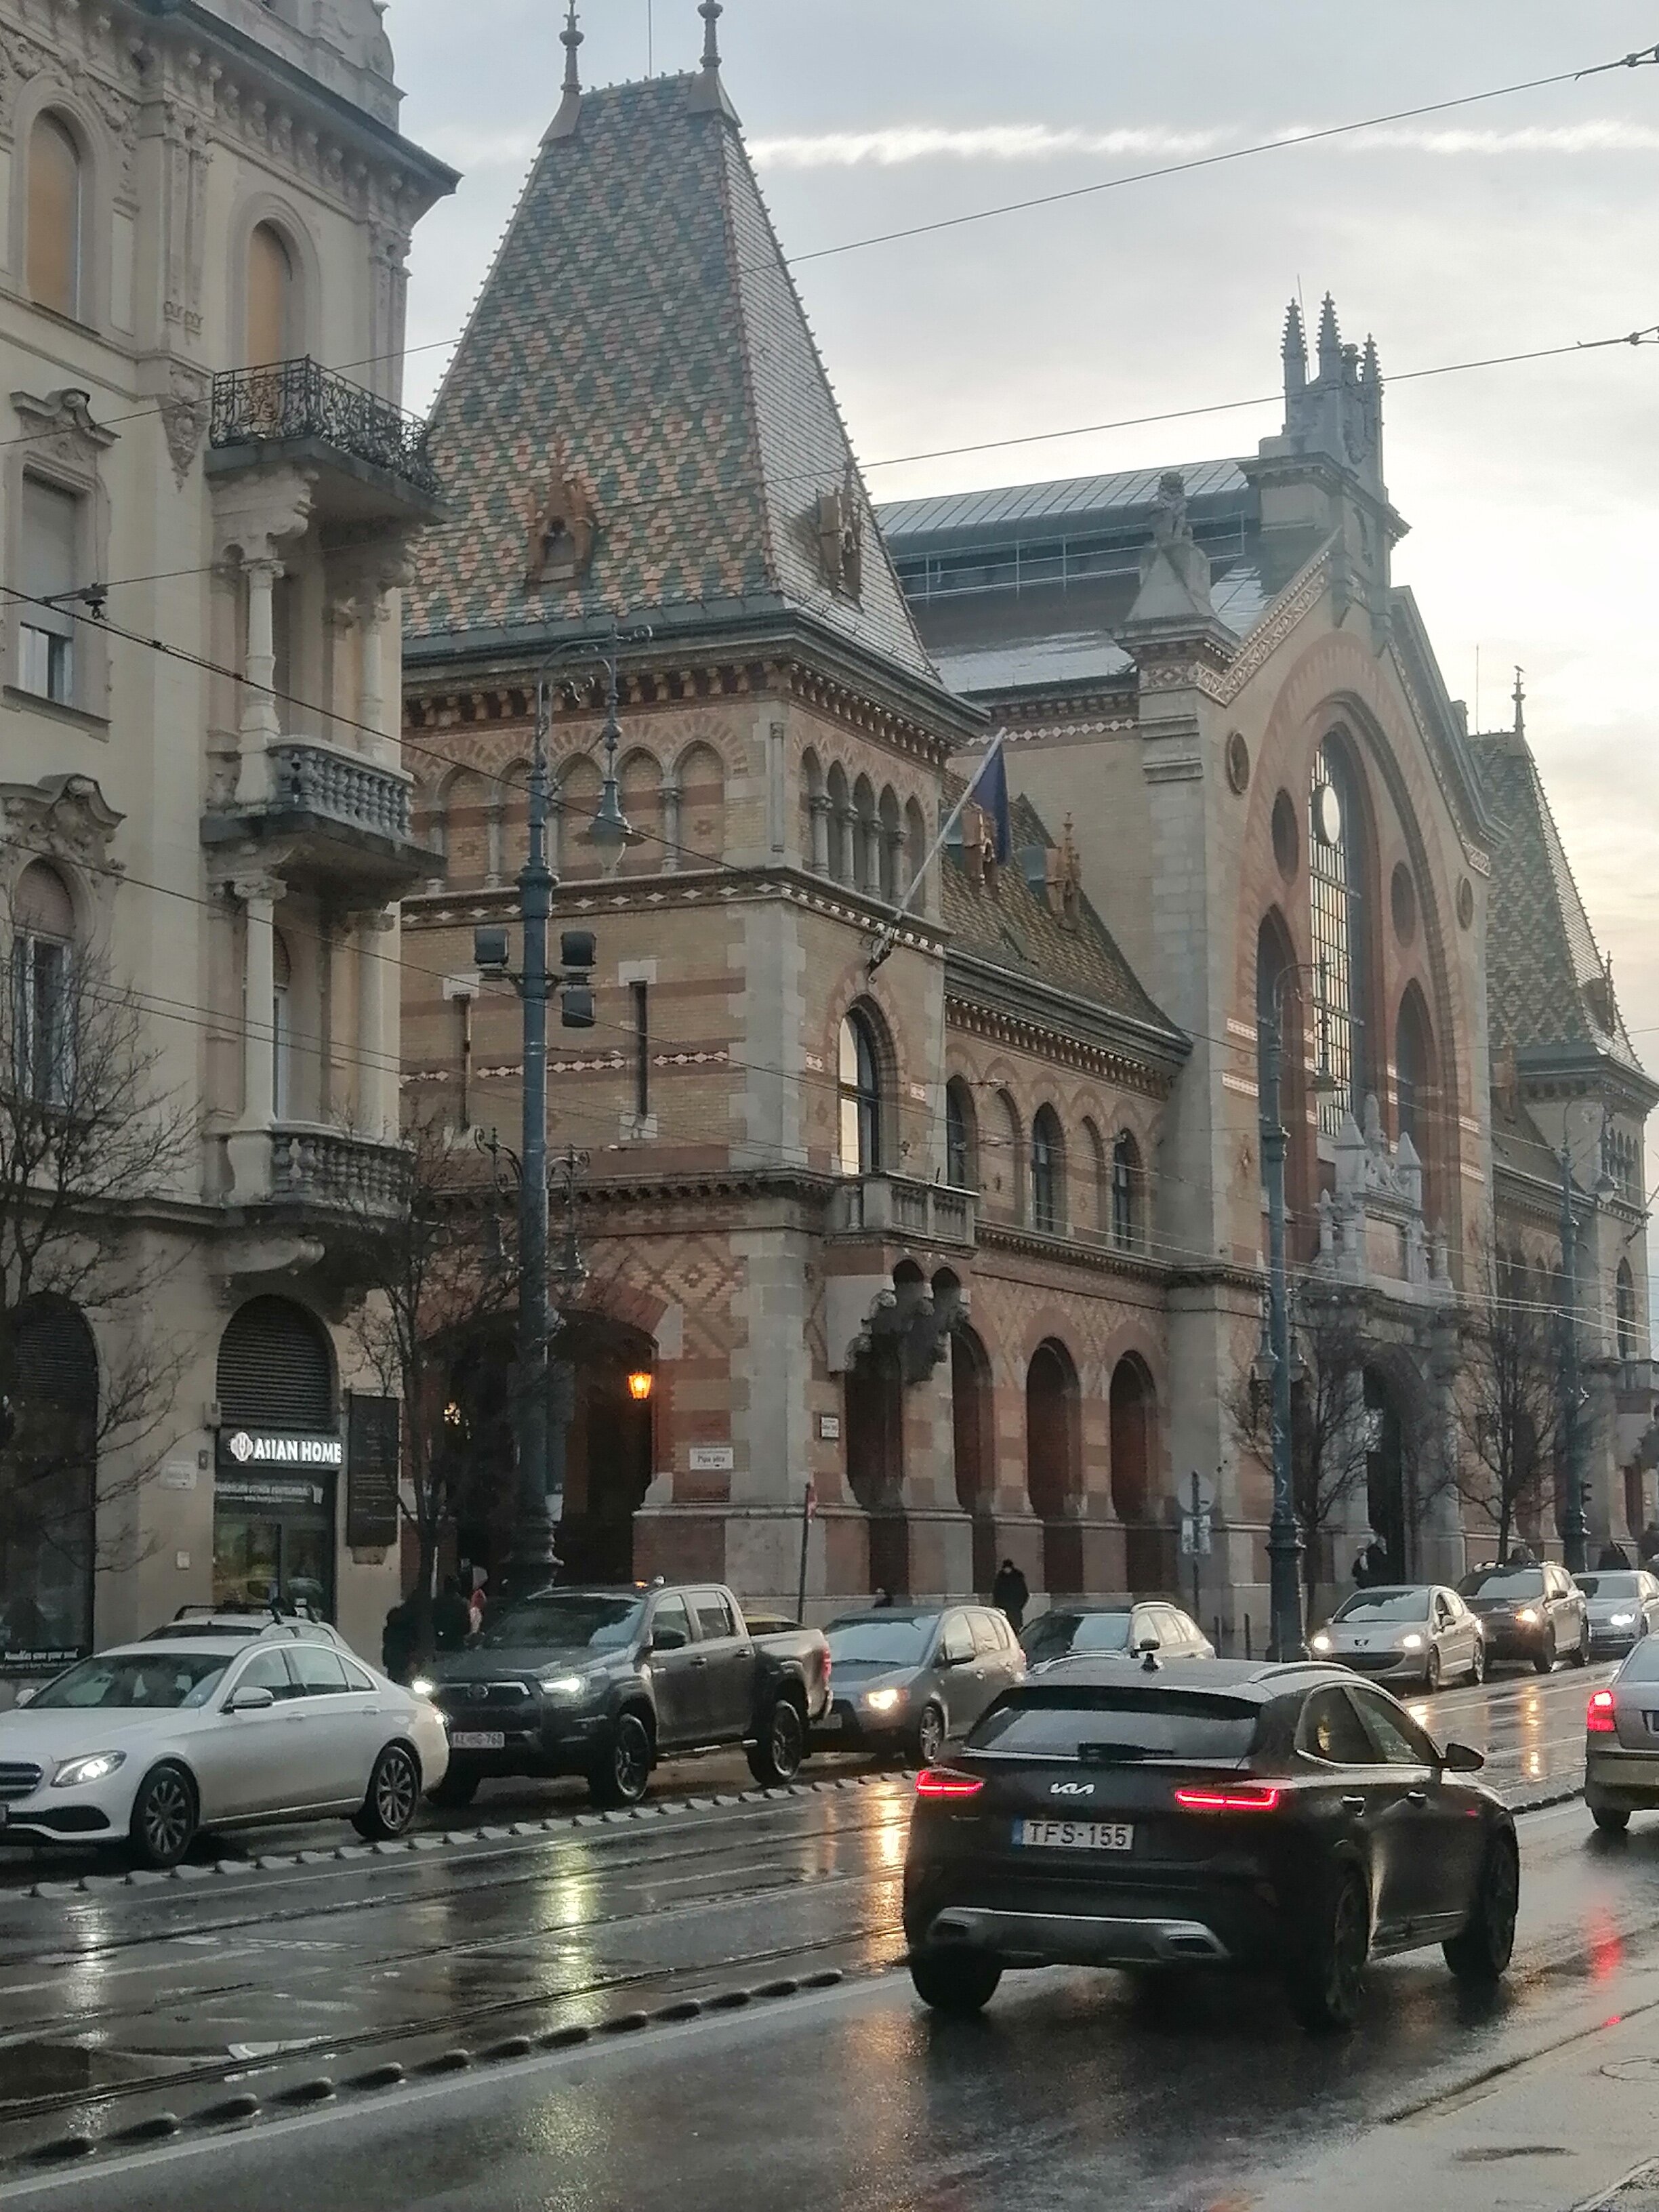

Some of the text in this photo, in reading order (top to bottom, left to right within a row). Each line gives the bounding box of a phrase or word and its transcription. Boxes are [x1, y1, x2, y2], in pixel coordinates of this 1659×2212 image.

[253, 1437, 342, 1464] ASIAN HOME
[1029, 1822, 1126, 1847] TFS-155
